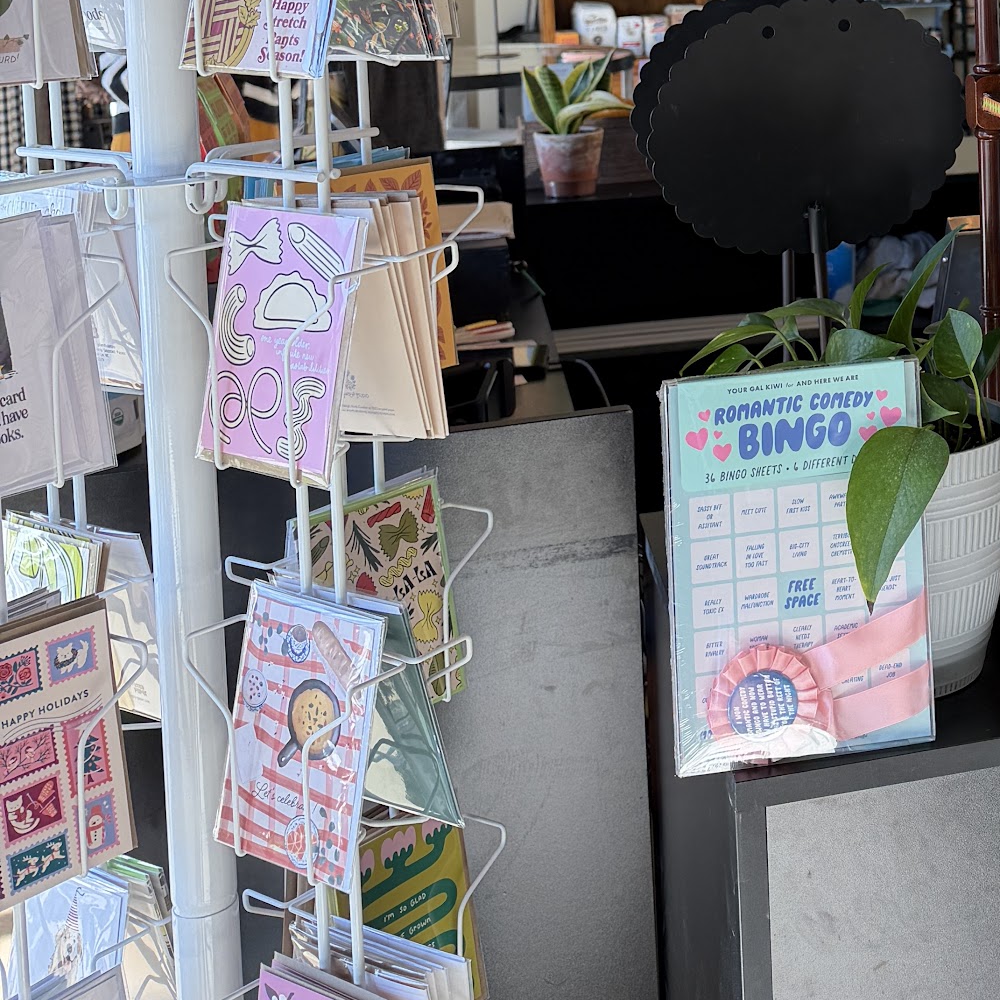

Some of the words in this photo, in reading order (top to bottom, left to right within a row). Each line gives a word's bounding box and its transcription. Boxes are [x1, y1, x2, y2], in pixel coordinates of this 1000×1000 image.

[727, 386, 748, 394] YOUR
[765, 383, 783, 391] KIWI
[813, 378, 831, 386] HERE
[1, 408, 29, 426] have
[714, 395, 802, 426] ROMANTIC
[809, 390, 873, 411] COMEDY
[738, 411, 852, 461] BINGO
[705, 472, 716, 484] 36
[719, 469, 747, 482] BINGO
[750, 464, 783, 477] SHEETS
[793, 461, 799, 472] 6
[803, 456, 848, 471] DIFFERENT
[788, 578, 816, 593] FREE
[741, 600, 774, 609] MALFUNCTION
[784, 593, 821, 609] SPACE
[1, 709, 35, 729] HAPPY
[39, 689, 89, 715] HOLIDAYS
[251, 781, 276, 800] Let's
